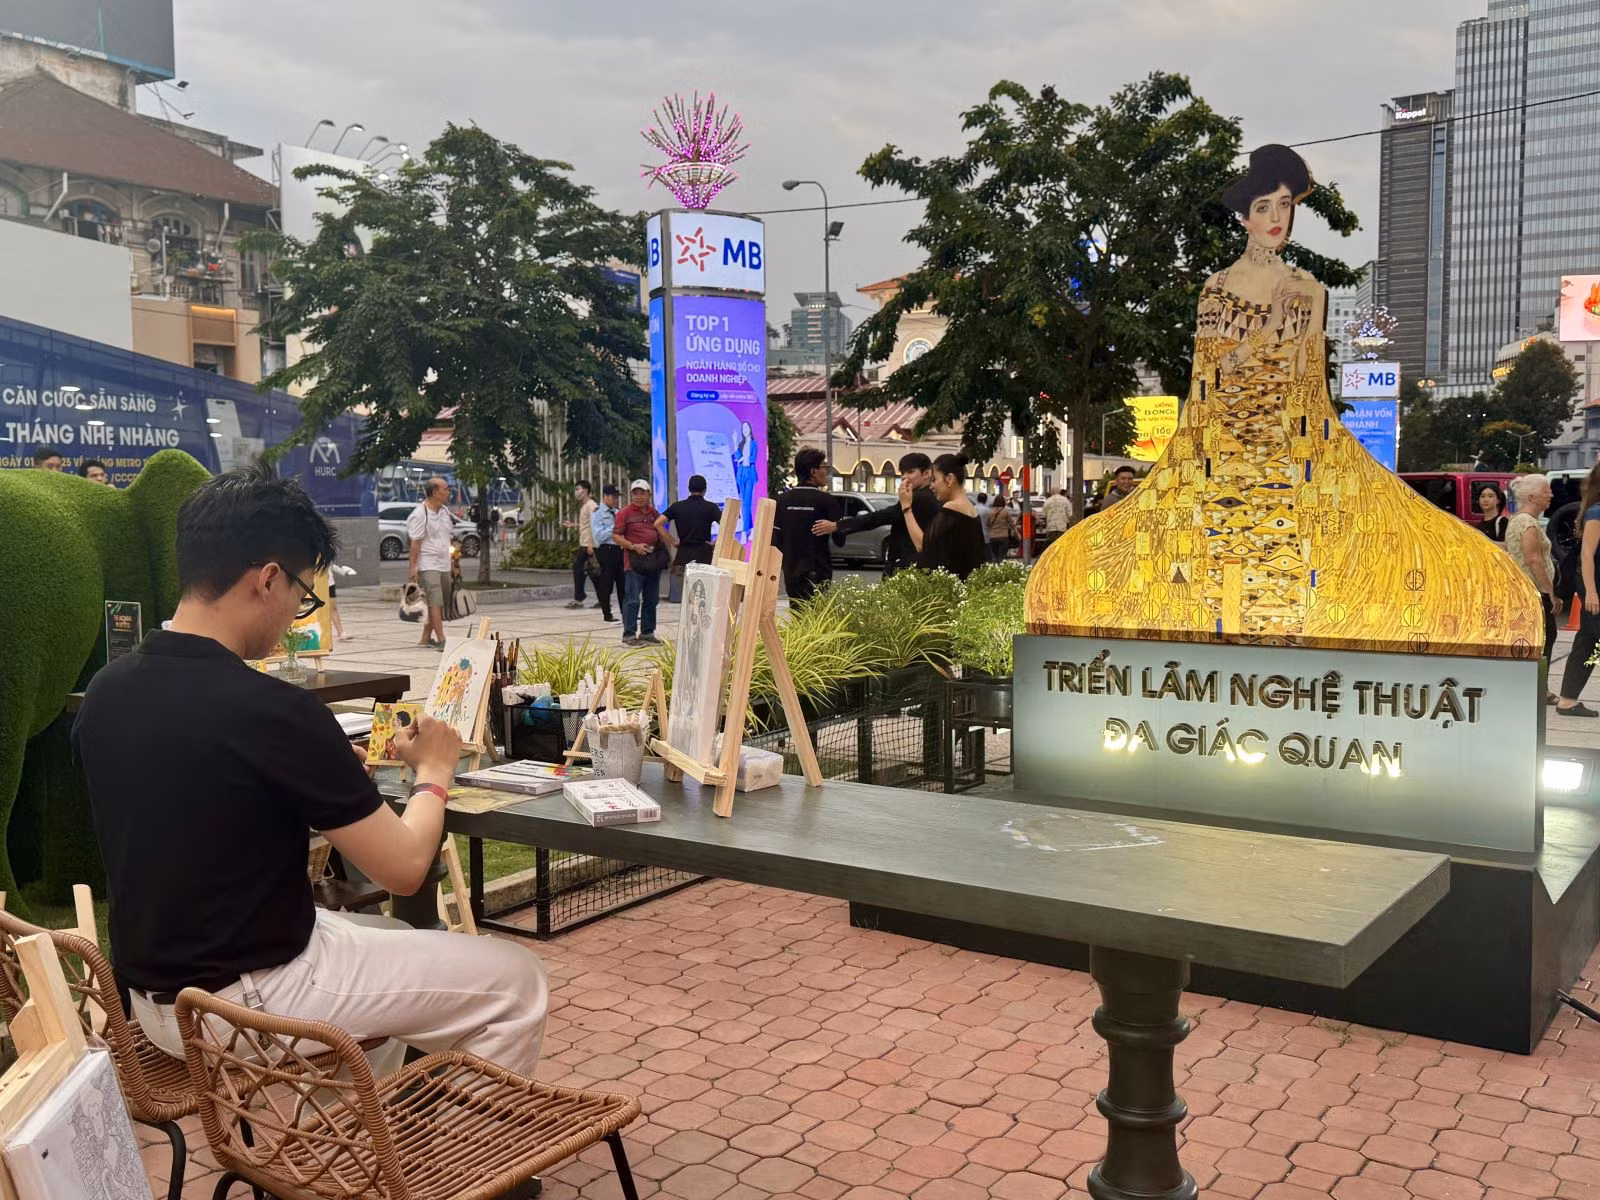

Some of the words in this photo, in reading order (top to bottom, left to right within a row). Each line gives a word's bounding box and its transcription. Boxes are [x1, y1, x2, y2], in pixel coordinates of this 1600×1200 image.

[1395, 108, 1426, 119] Keppel
[722, 238, 762, 270] MB
[685, 315, 719, 332] TOP
[722, 316, 729, 332] 1
[686, 333, 722, 353] ỨNG
[725, 338, 760, 358] DỤNG
[686, 373, 719, 383] DOANH
[720, 373, 748, 386] NGHIỆP
[1368, 372, 1396, 386] MB
[3, 386, 38, 406] CĂN
[120, 392, 157, 413] SÀNG
[1374, 406, 1393, 418] VỐN
[6, 417, 74, 445] THÁNG
[80, 424, 114, 451] NHẸ
[119, 422, 180, 448] NHÀNG
[115, 458, 142, 467] METRO
[314, 466, 337, 477] HURC
[1043, 649, 1132, 696] TRIỂN
[1230, 670, 1343, 719] NGHỆ
[1353, 677, 1487, 728] THUẬT
[1103, 717, 1159, 752] ĐA
[1166, 717, 1269, 764] GIÁC
[1277, 732, 1402, 777] QUAN
